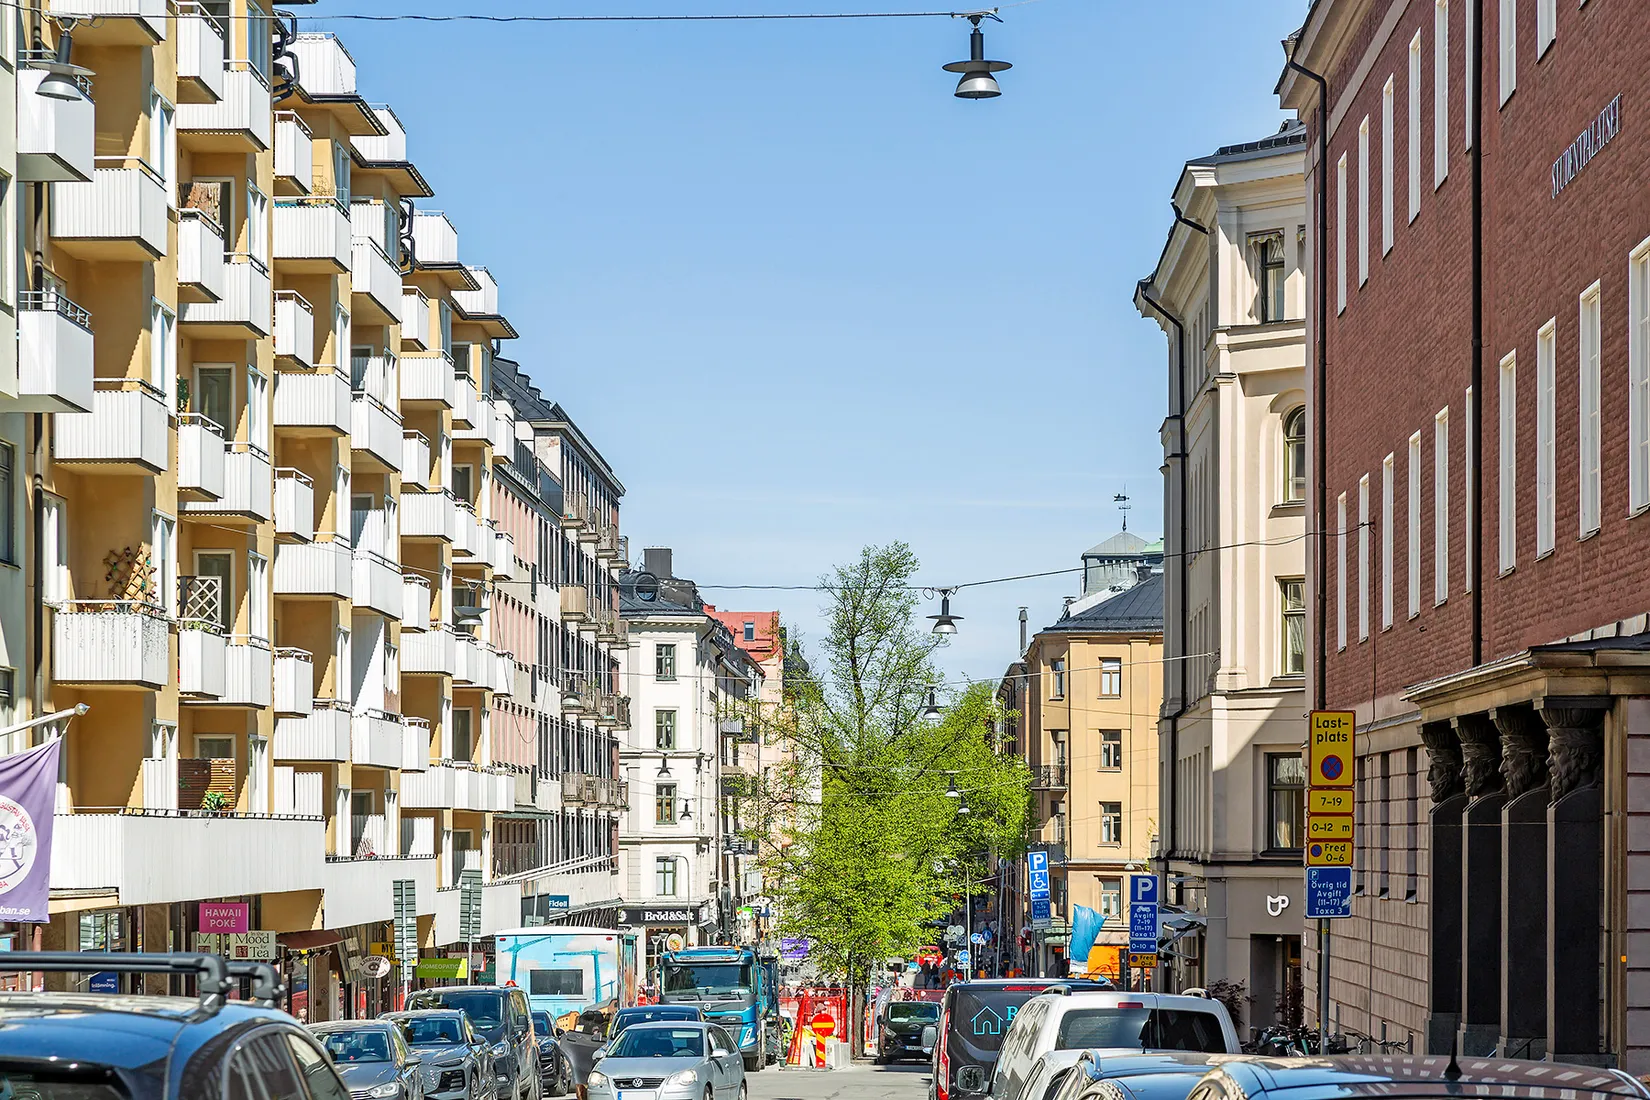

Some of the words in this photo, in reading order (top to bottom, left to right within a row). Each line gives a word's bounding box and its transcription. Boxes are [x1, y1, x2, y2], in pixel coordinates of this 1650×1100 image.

[1316, 717, 1349, 728] Last-
[1316, 731, 1348, 745] plats
[1320, 797, 1343, 806] 7-19
[1311, 823, 1333, 832] 0-12
[1341, 824, 1350, 832] m
[1324, 843, 1346, 852] Fred
[1033, 854, 1044, 870] P
[1325, 853, 1345, 862] 0-6
[1311, 870, 1317, 879] P
[1137, 877, 1154, 900] P
[1311, 880, 1334, 890] Övrig
[1336, 881, 1347, 889] tid
[1316, 890, 1342, 899] Avgift
[1317, 898, 1340, 907] (11-17)
[205, 908, 241, 917] HAWAII
[1315, 907, 1335, 915] Taxa
[1337, 906, 1343, 915] 3
[235, 932, 269, 944] Mood
[249, 946, 270, 958] Tea
